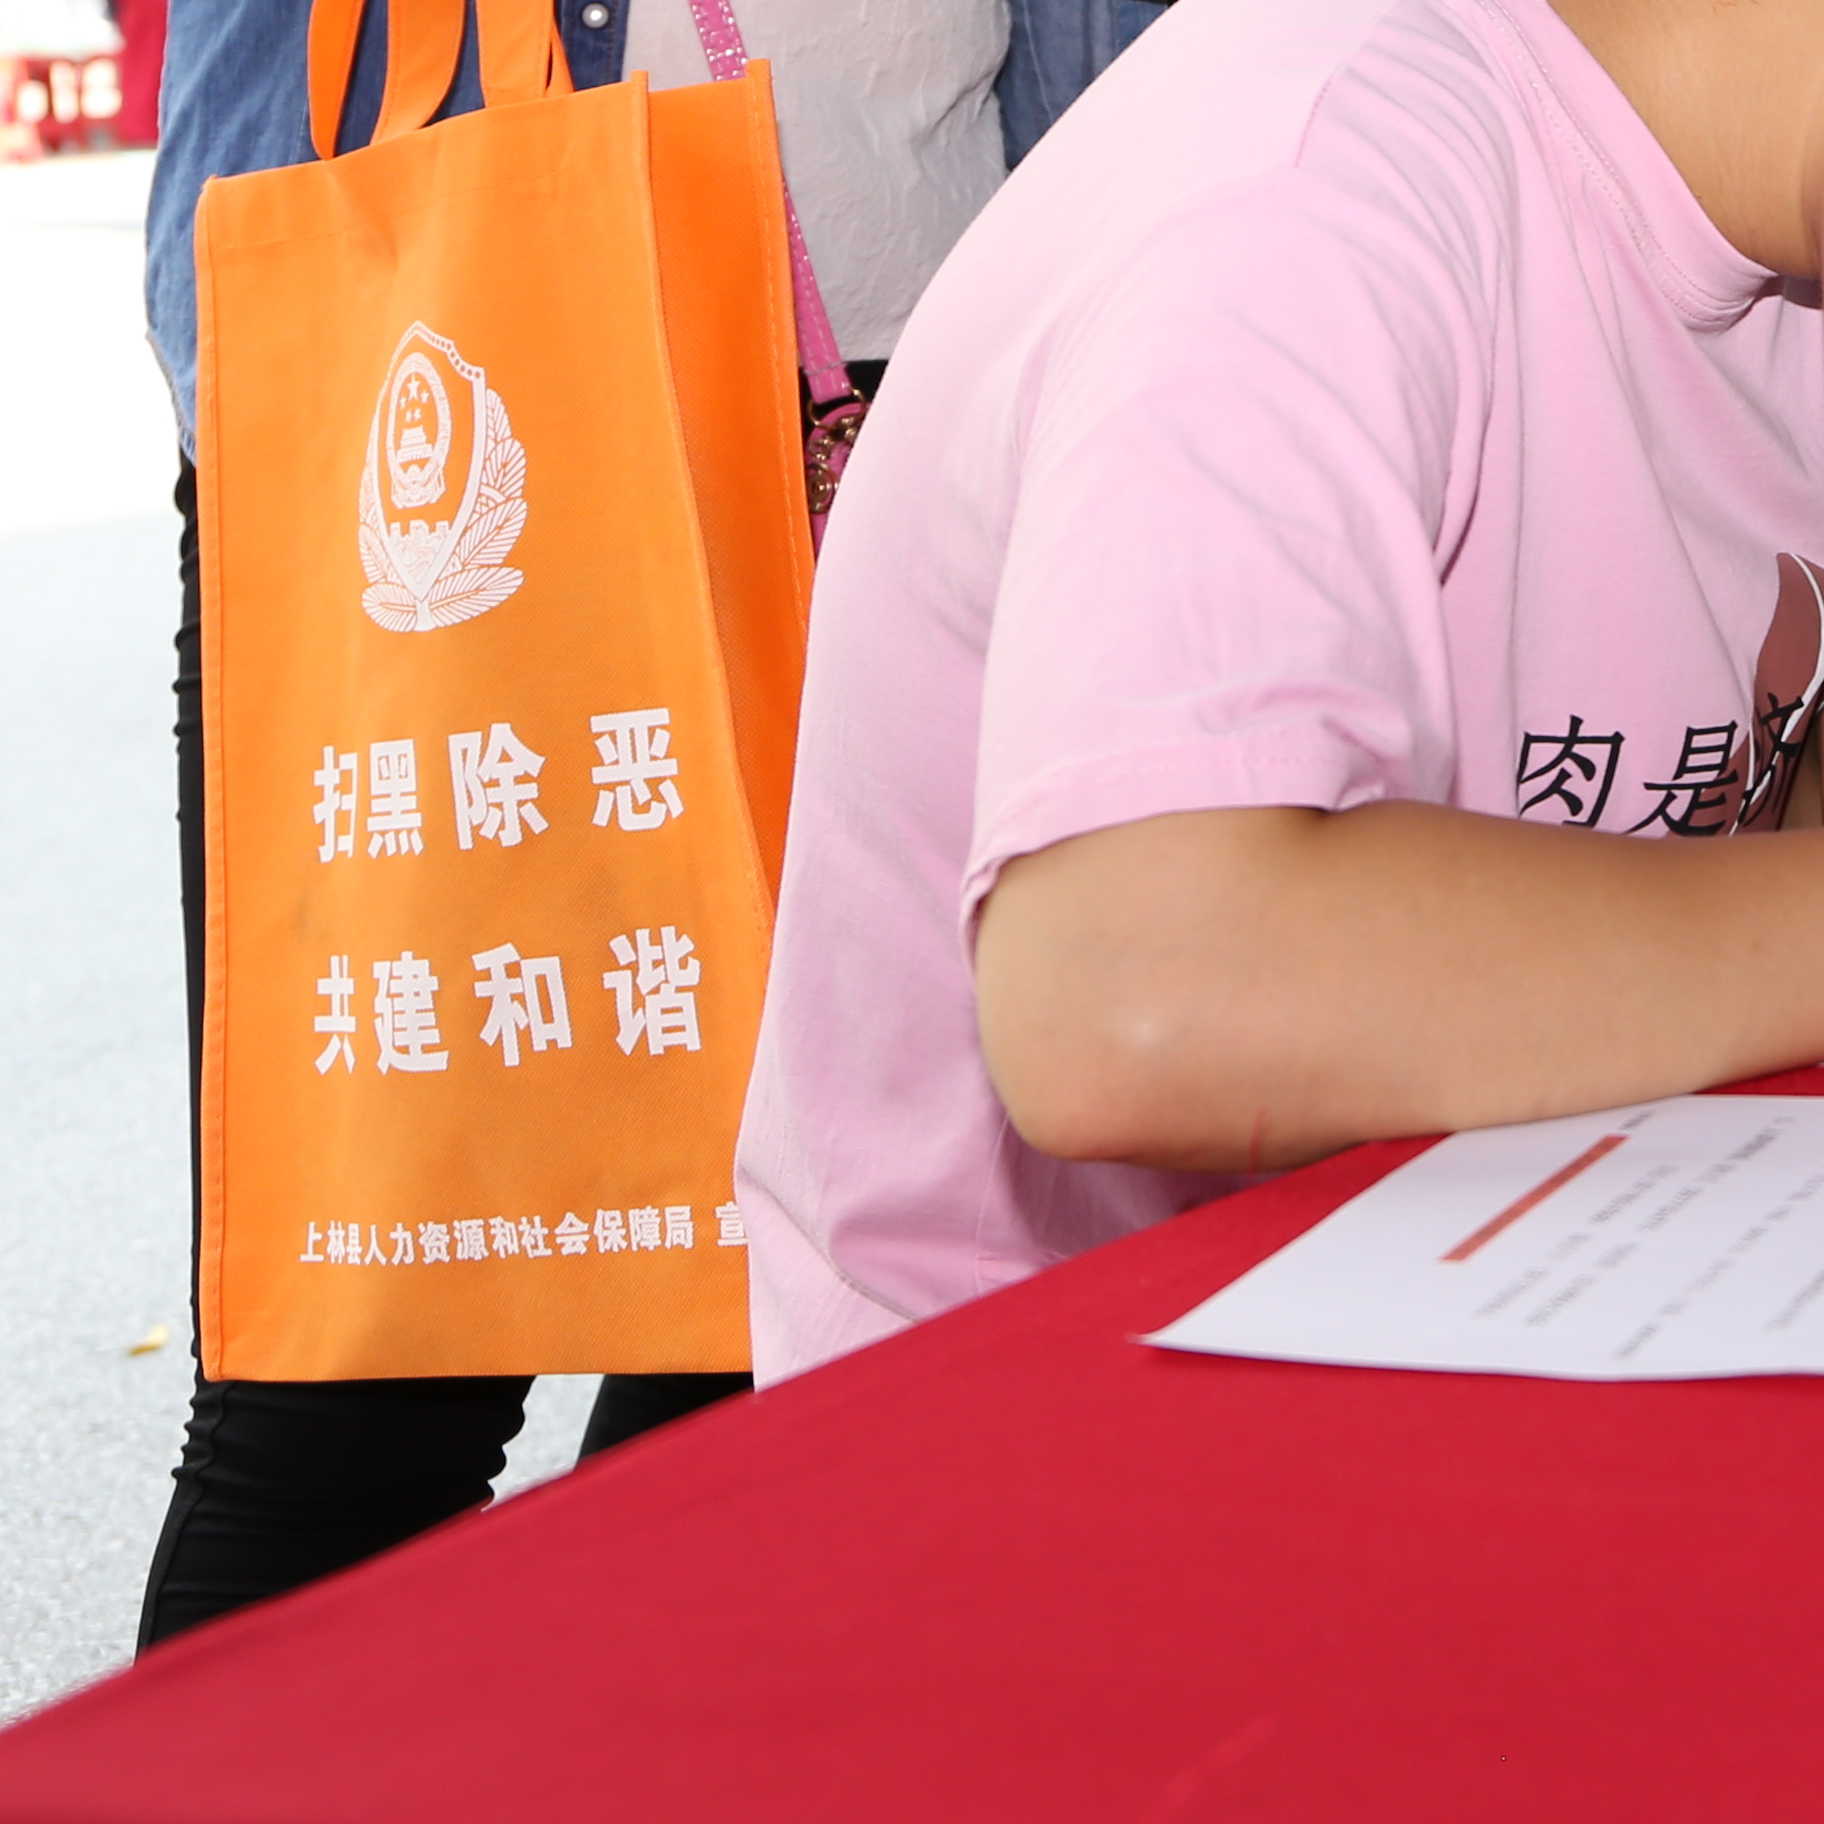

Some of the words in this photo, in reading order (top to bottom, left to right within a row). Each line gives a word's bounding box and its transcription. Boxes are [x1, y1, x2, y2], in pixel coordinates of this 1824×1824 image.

[313, 707, 684, 863] 扫黑除恶
[313, 925, 701, 1076] 共建和谐
[299, 1205, 695, 1266] 上林县人力资源和社会保障局
